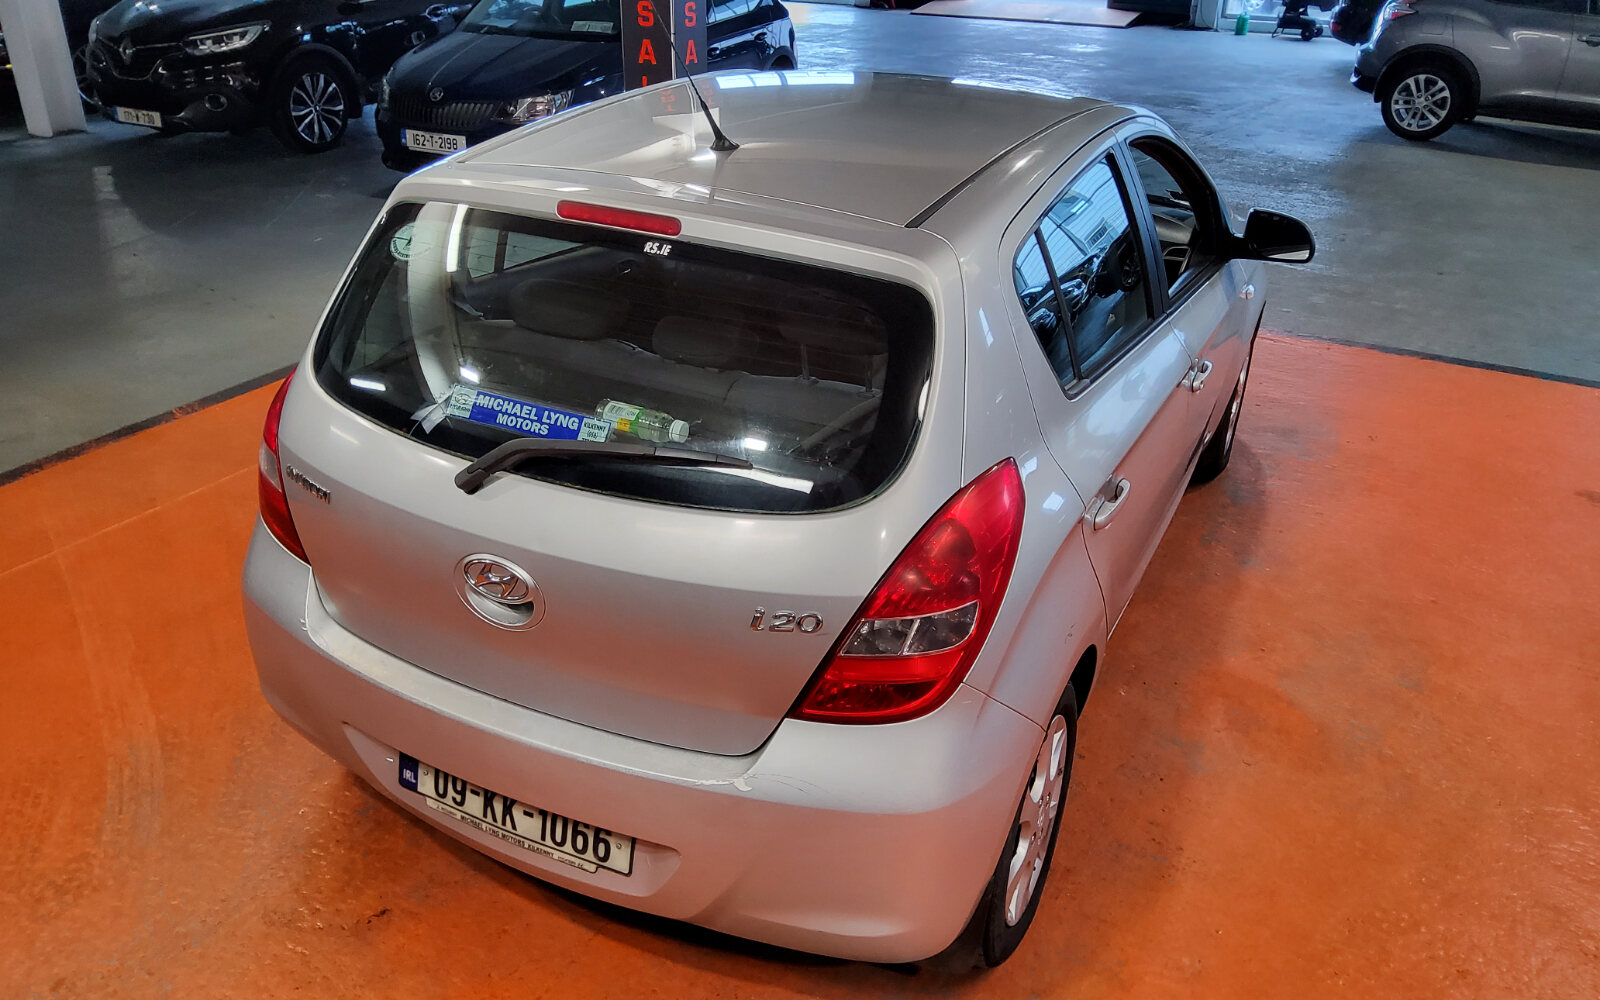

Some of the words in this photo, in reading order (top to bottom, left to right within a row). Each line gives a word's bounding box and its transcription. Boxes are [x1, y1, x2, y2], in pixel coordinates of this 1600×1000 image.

[412, 133, 458, 150] 162-T-2198
[643, 241, 672, 256] RS.IE
[475, 394, 538, 420] MICHAEL
[541, 410, 579, 431] LYNG
[496, 412, 550, 436] MOTORS
[750, 606, 824, 634] i20
[403, 768, 417, 784] IRL
[433, 768, 612, 864] 09-KK-1066
[460, 814, 484, 831] MICHAEL
[485, 826, 500, 838] LYNG
[501, 832, 526, 848] MOTORS
[527, 843, 555, 858] KILKENNY
